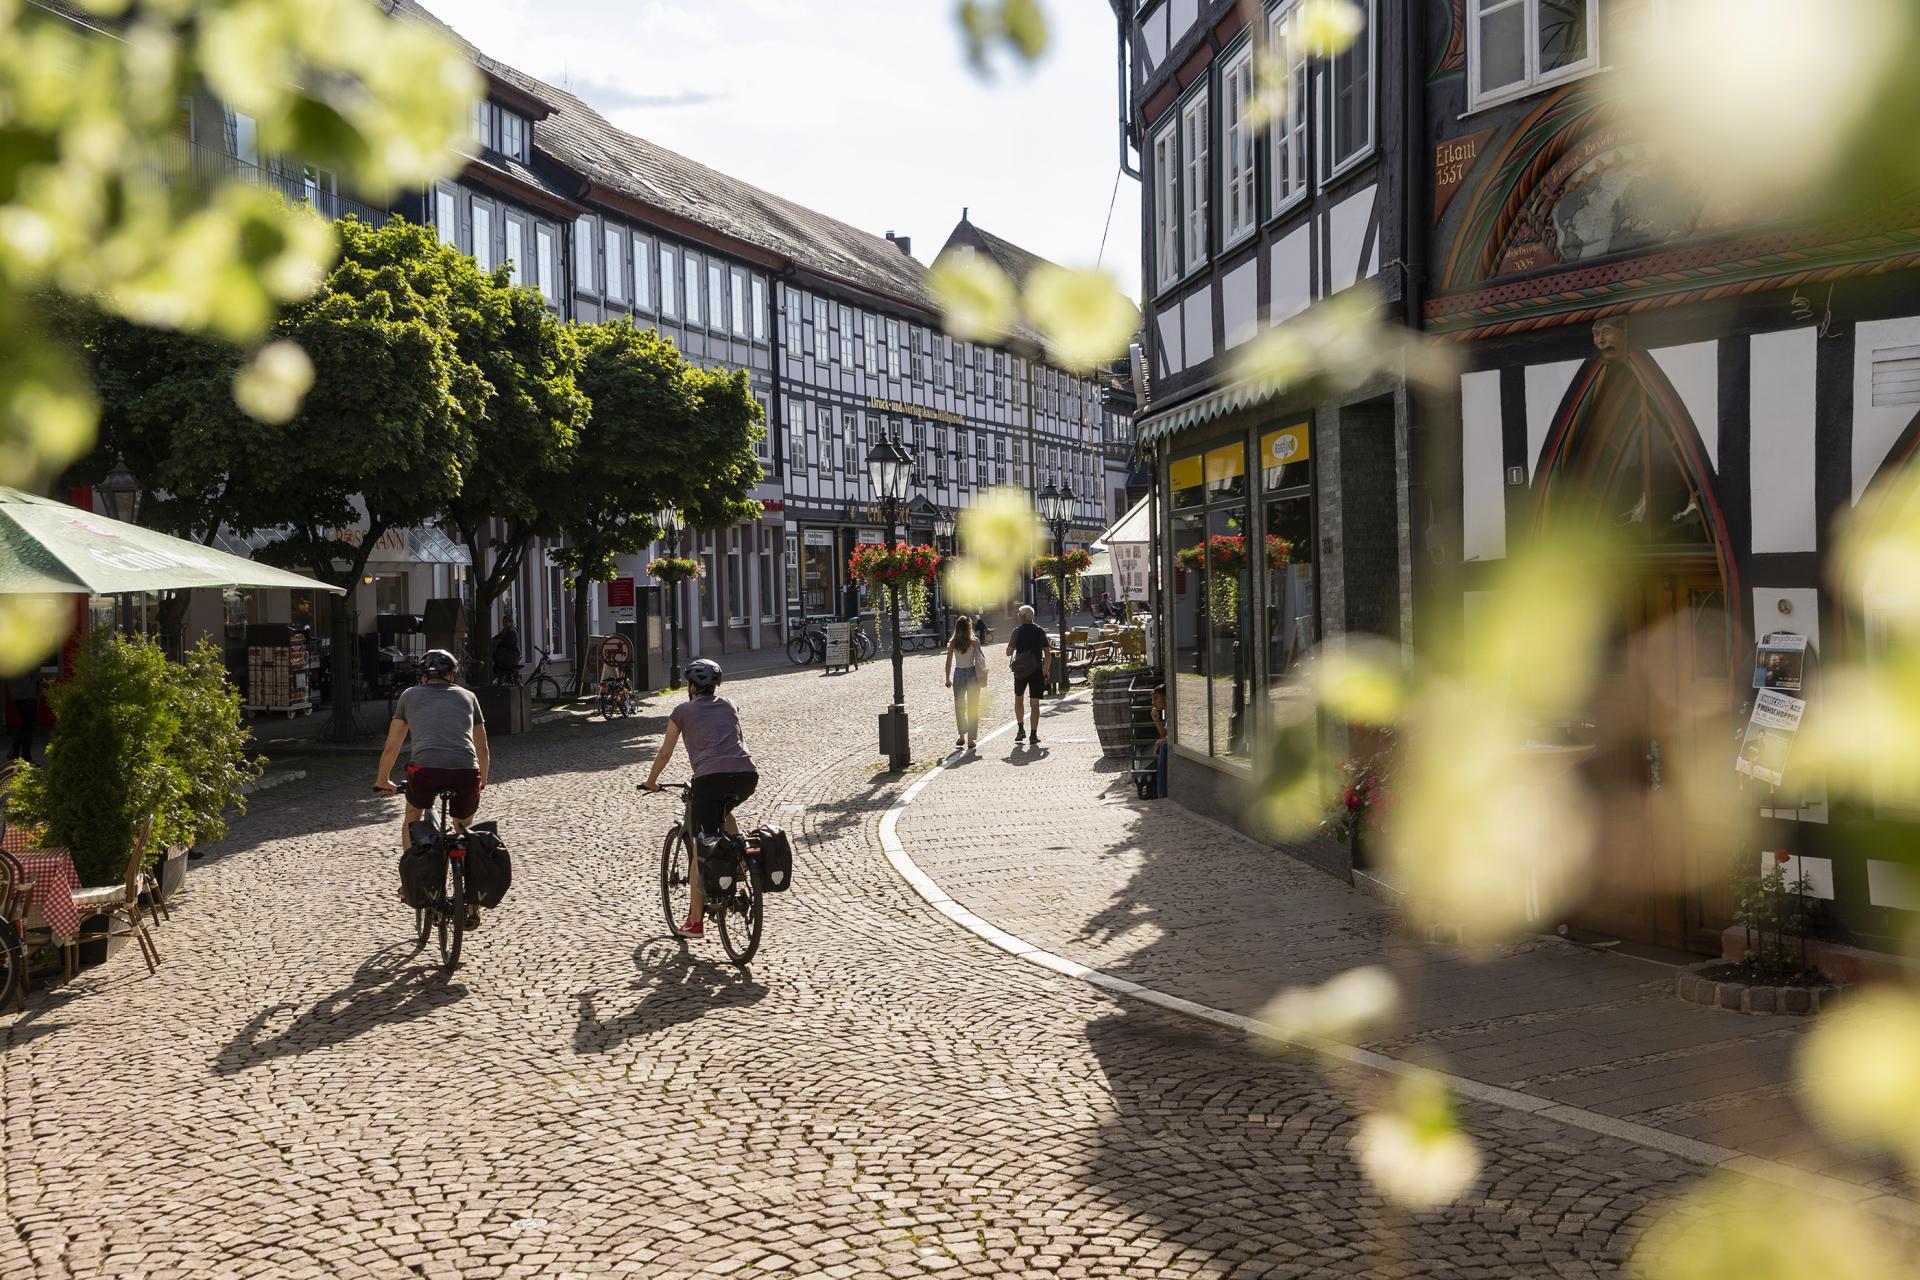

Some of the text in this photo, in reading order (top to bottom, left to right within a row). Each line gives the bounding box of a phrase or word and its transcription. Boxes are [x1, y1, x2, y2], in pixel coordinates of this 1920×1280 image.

[1436, 139, 1476, 167] Erbaut
[1437, 162, 1464, 185] 1557
[335, 526, 404, 552] ROSANN
